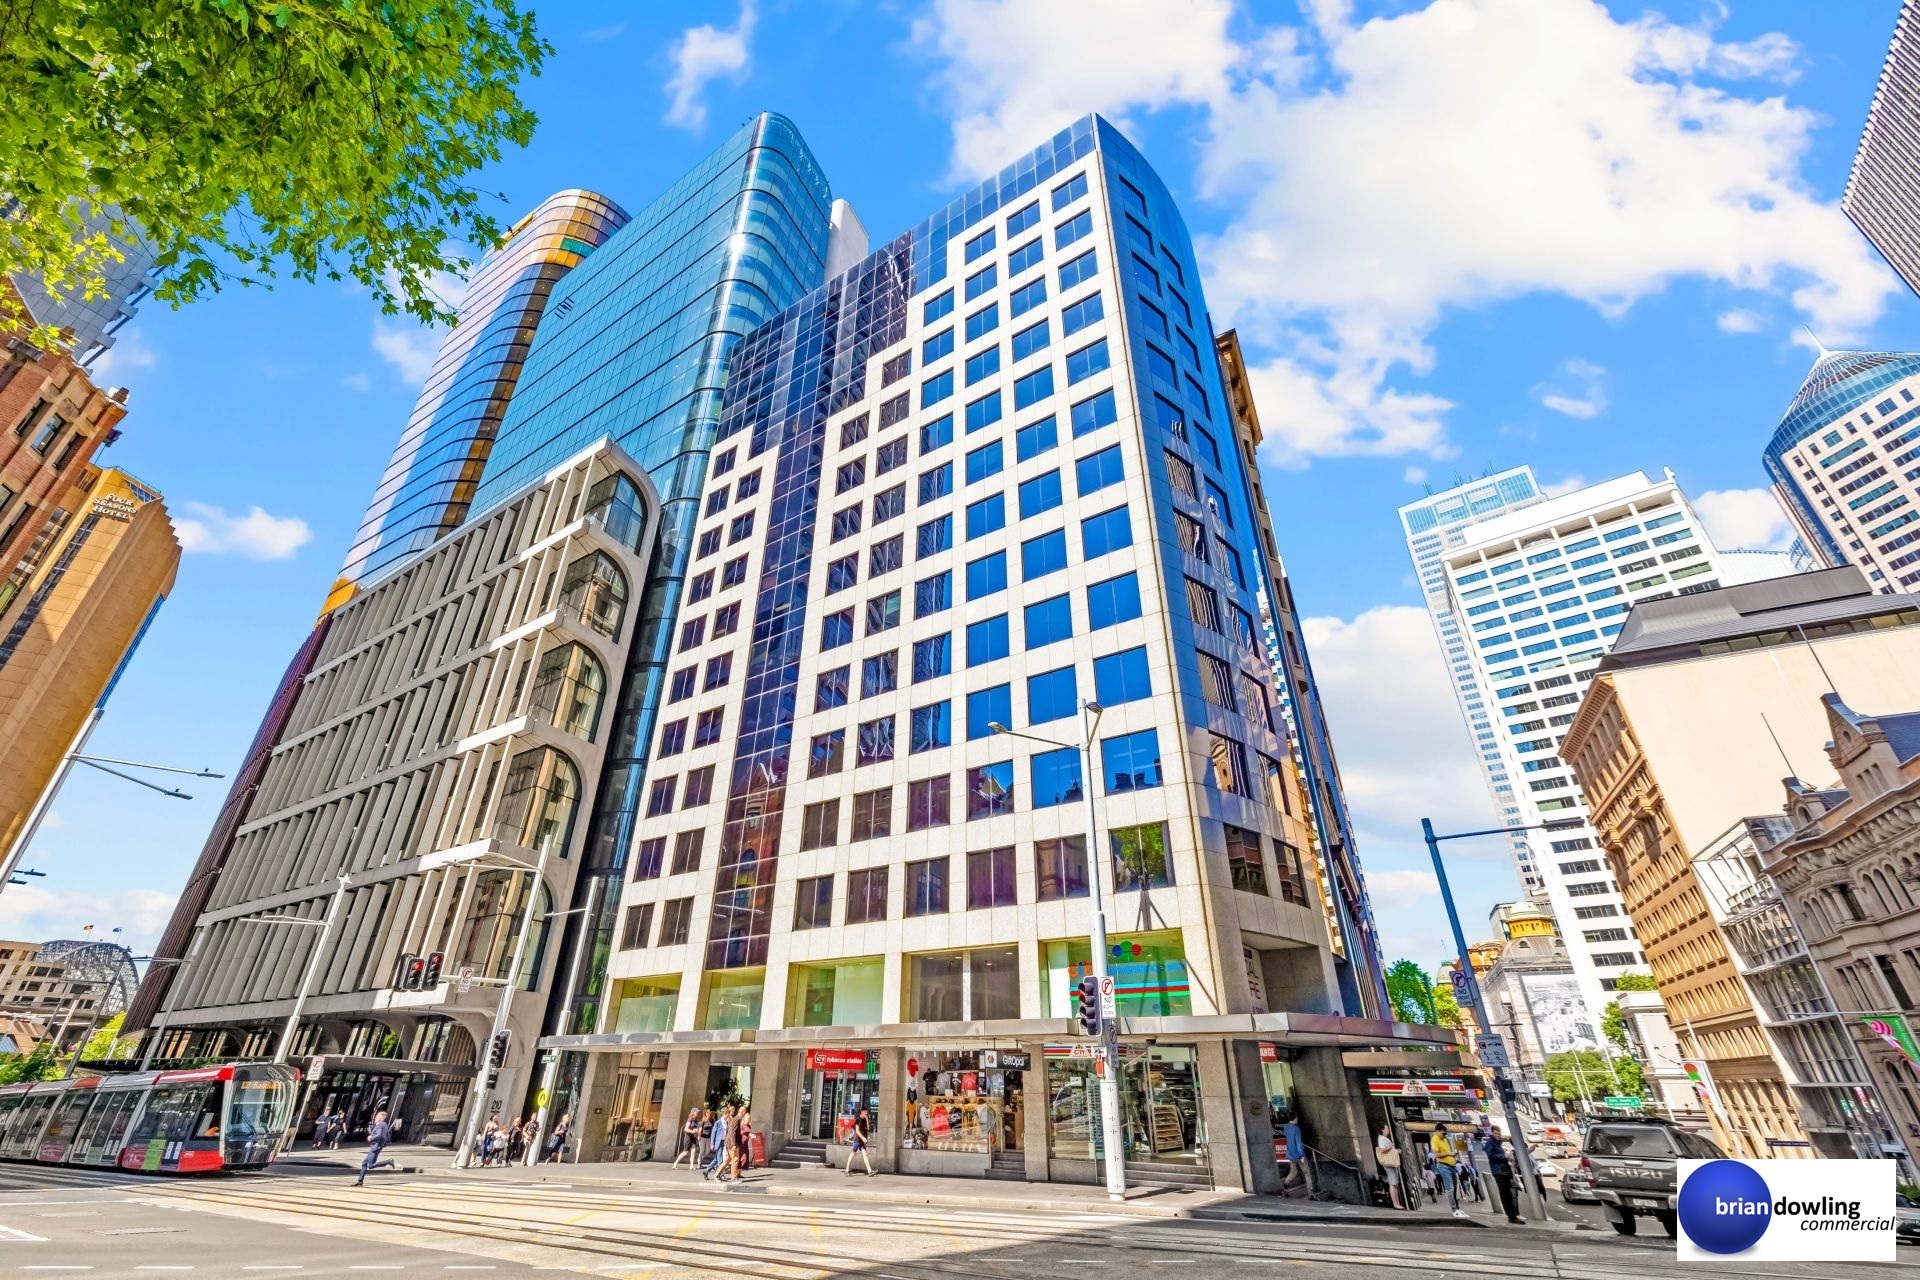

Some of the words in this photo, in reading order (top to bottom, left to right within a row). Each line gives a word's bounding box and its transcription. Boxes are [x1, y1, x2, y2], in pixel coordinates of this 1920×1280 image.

[94, 498, 137, 513] SEASONS
[105, 494, 132, 506] FOUR
[93, 504, 129, 519] HOTEL
[491, 1100, 503, 1111] 210
[1609, 1167, 1664, 1180] ISUZU
